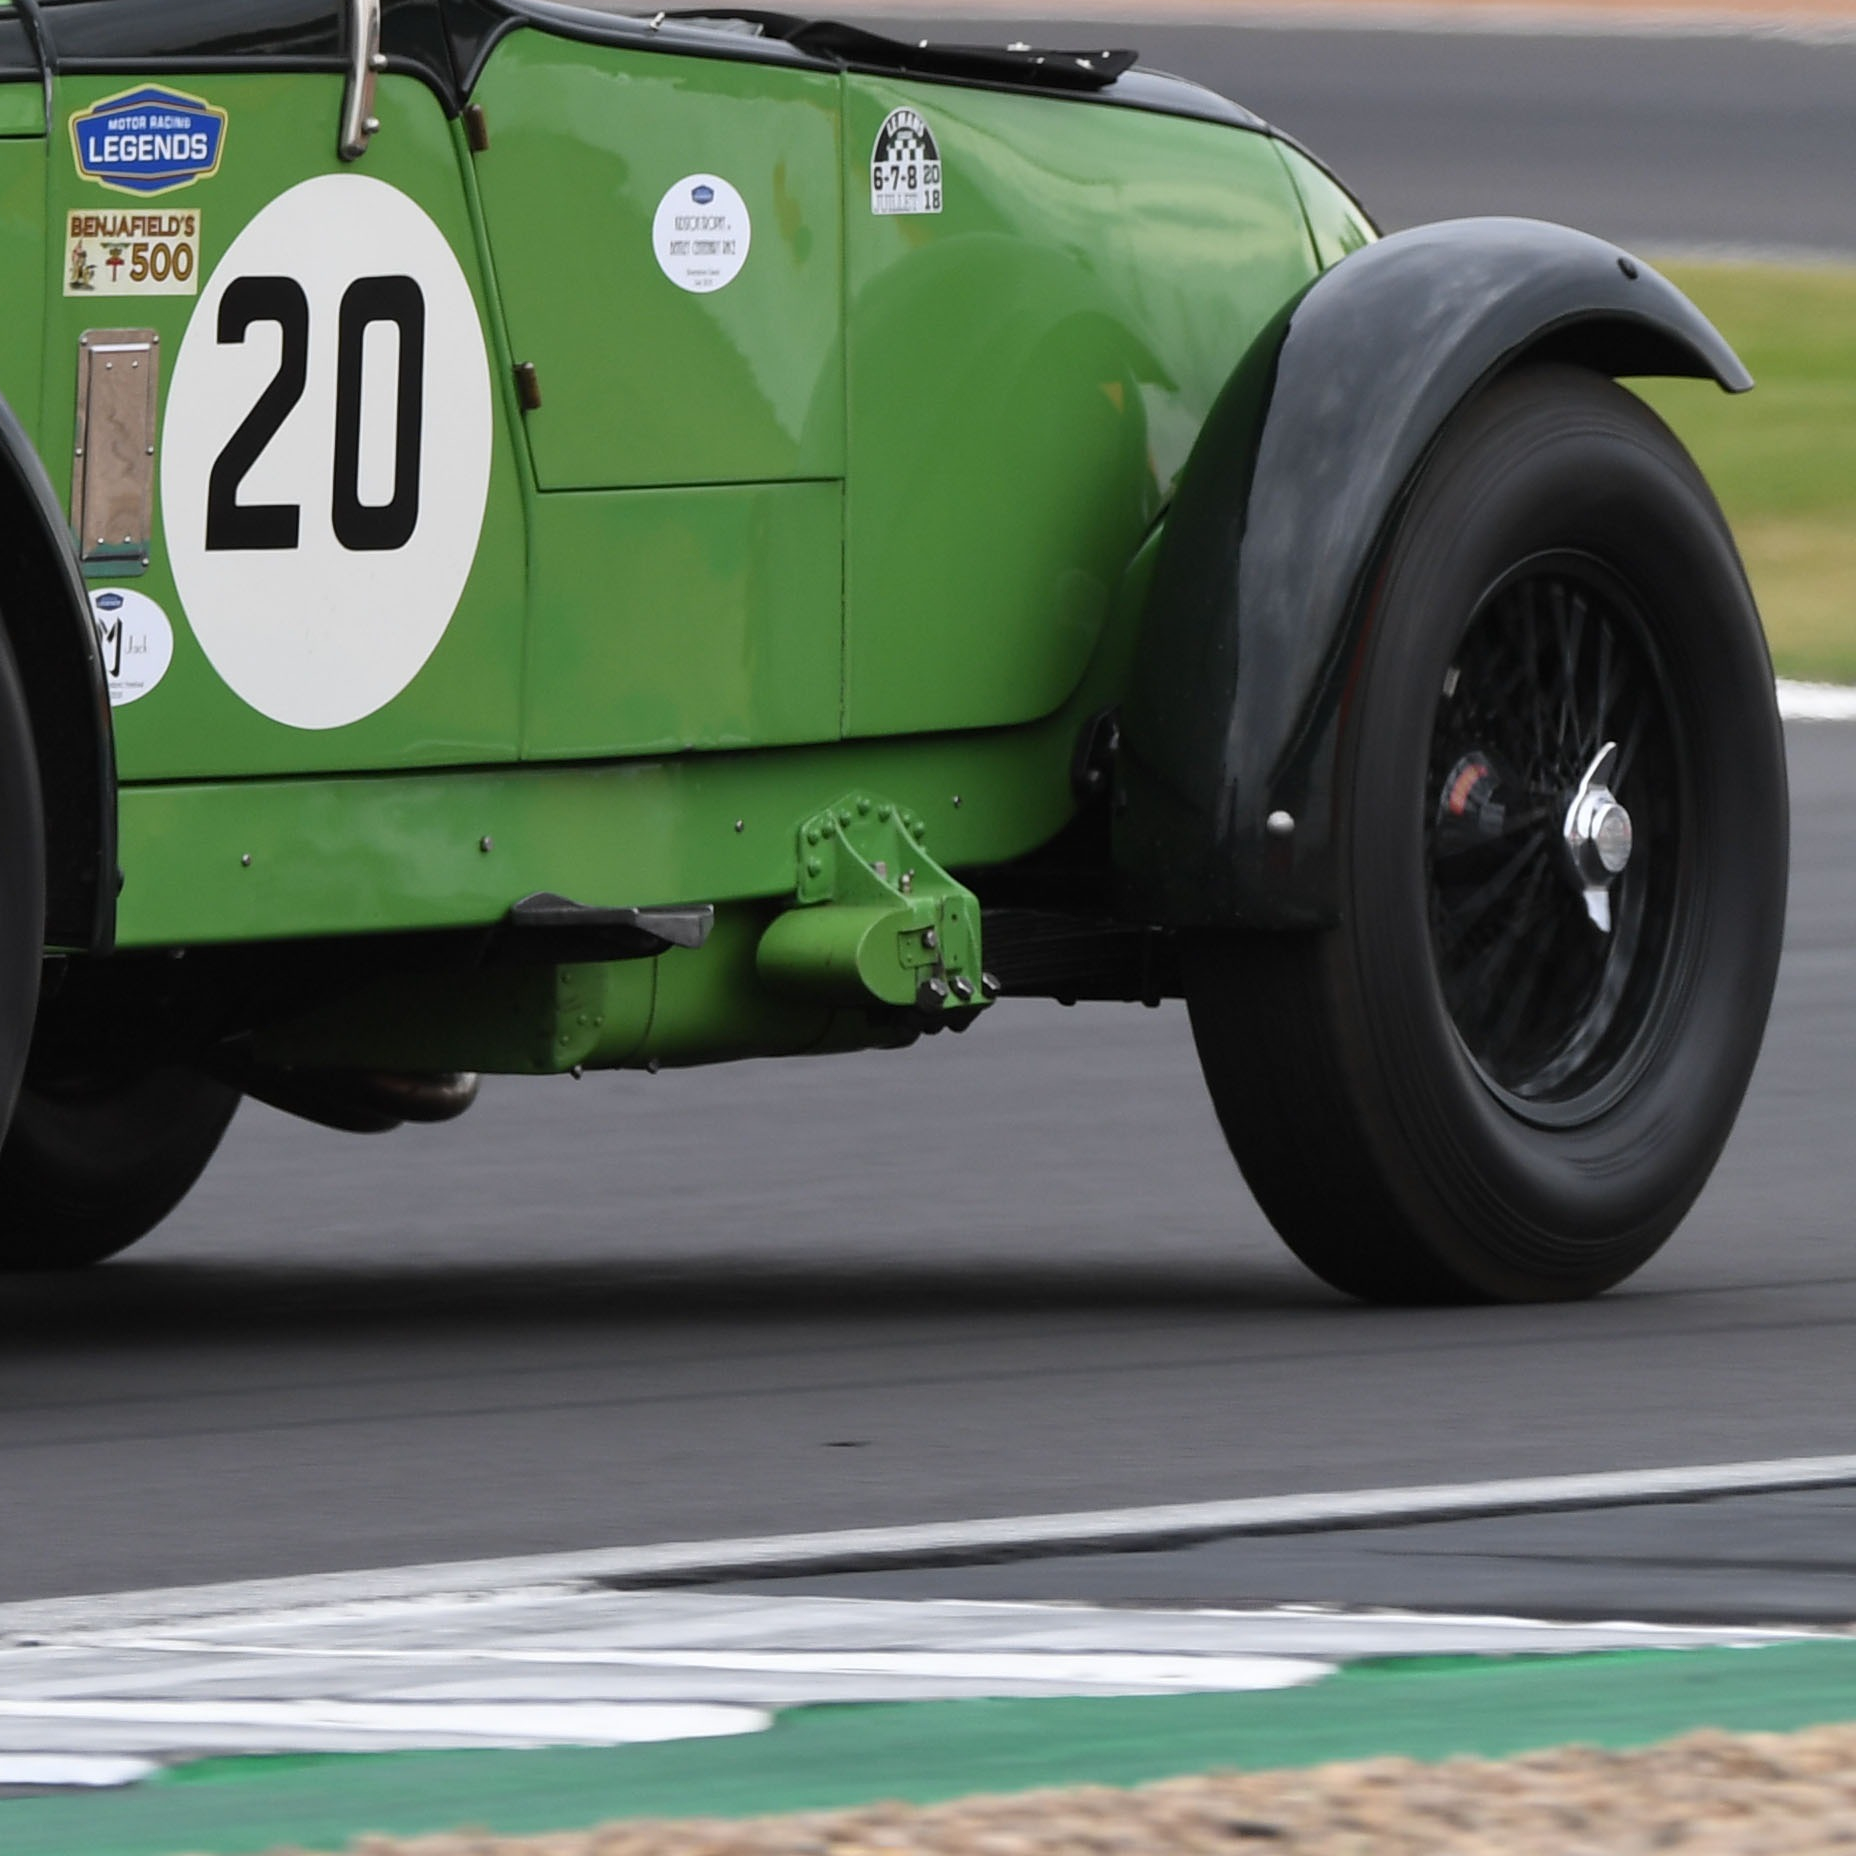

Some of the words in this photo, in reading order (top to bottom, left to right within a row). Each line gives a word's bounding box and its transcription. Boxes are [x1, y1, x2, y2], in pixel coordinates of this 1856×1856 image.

[108, 116, 147, 131] MOTOR
[149, 114, 192, 130] RACING
[88, 132, 209, 163] LEGENDS
[70, 215, 196, 238] BENJAFIELD'S
[129, 242, 194, 282] 500
[204, 274, 426, 552] 20
